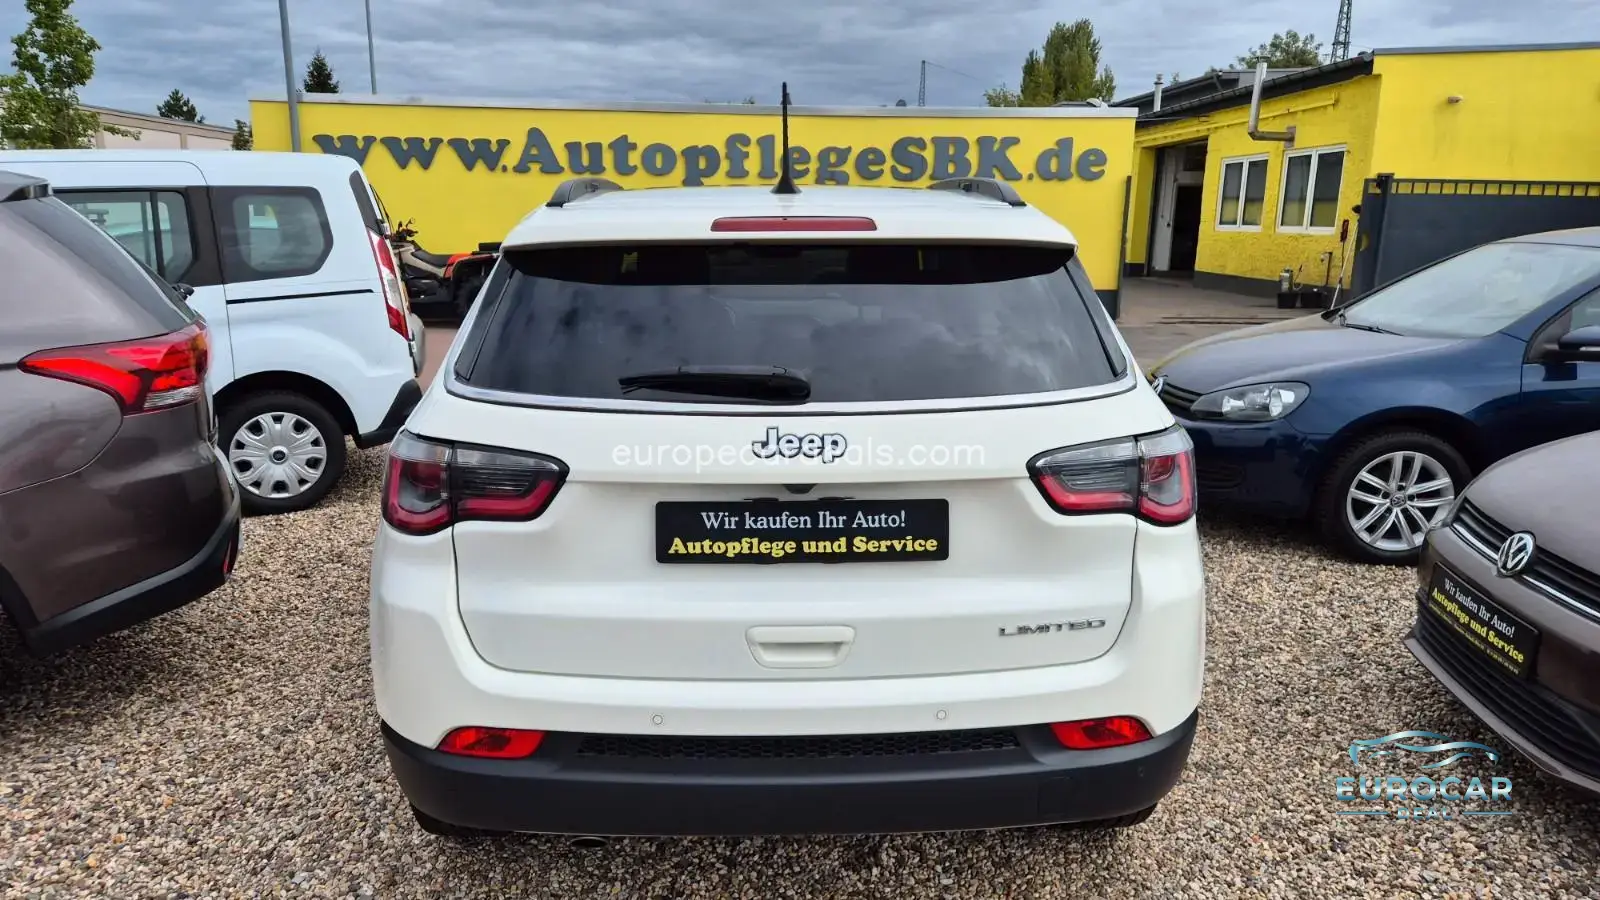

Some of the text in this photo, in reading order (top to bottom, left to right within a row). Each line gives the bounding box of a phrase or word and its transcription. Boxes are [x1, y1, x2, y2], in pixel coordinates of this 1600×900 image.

[312, 127, 1108, 186] www.AutopflegeSBK.de
[752, 426, 847, 463] Jeep
[701, 510, 906, 530] Wir kaufen Ihr Auto!
[668, 534, 938, 557] Autopflege und Service
[1432, 587, 1469, 625] Autopflege
[1469, 616, 1488, 638] und
[1487, 631, 1524, 663] Service
[1444, 578, 1515, 638] Wir kaufen Ihr Auto!
[998, 619, 1106, 636] LIMITED
